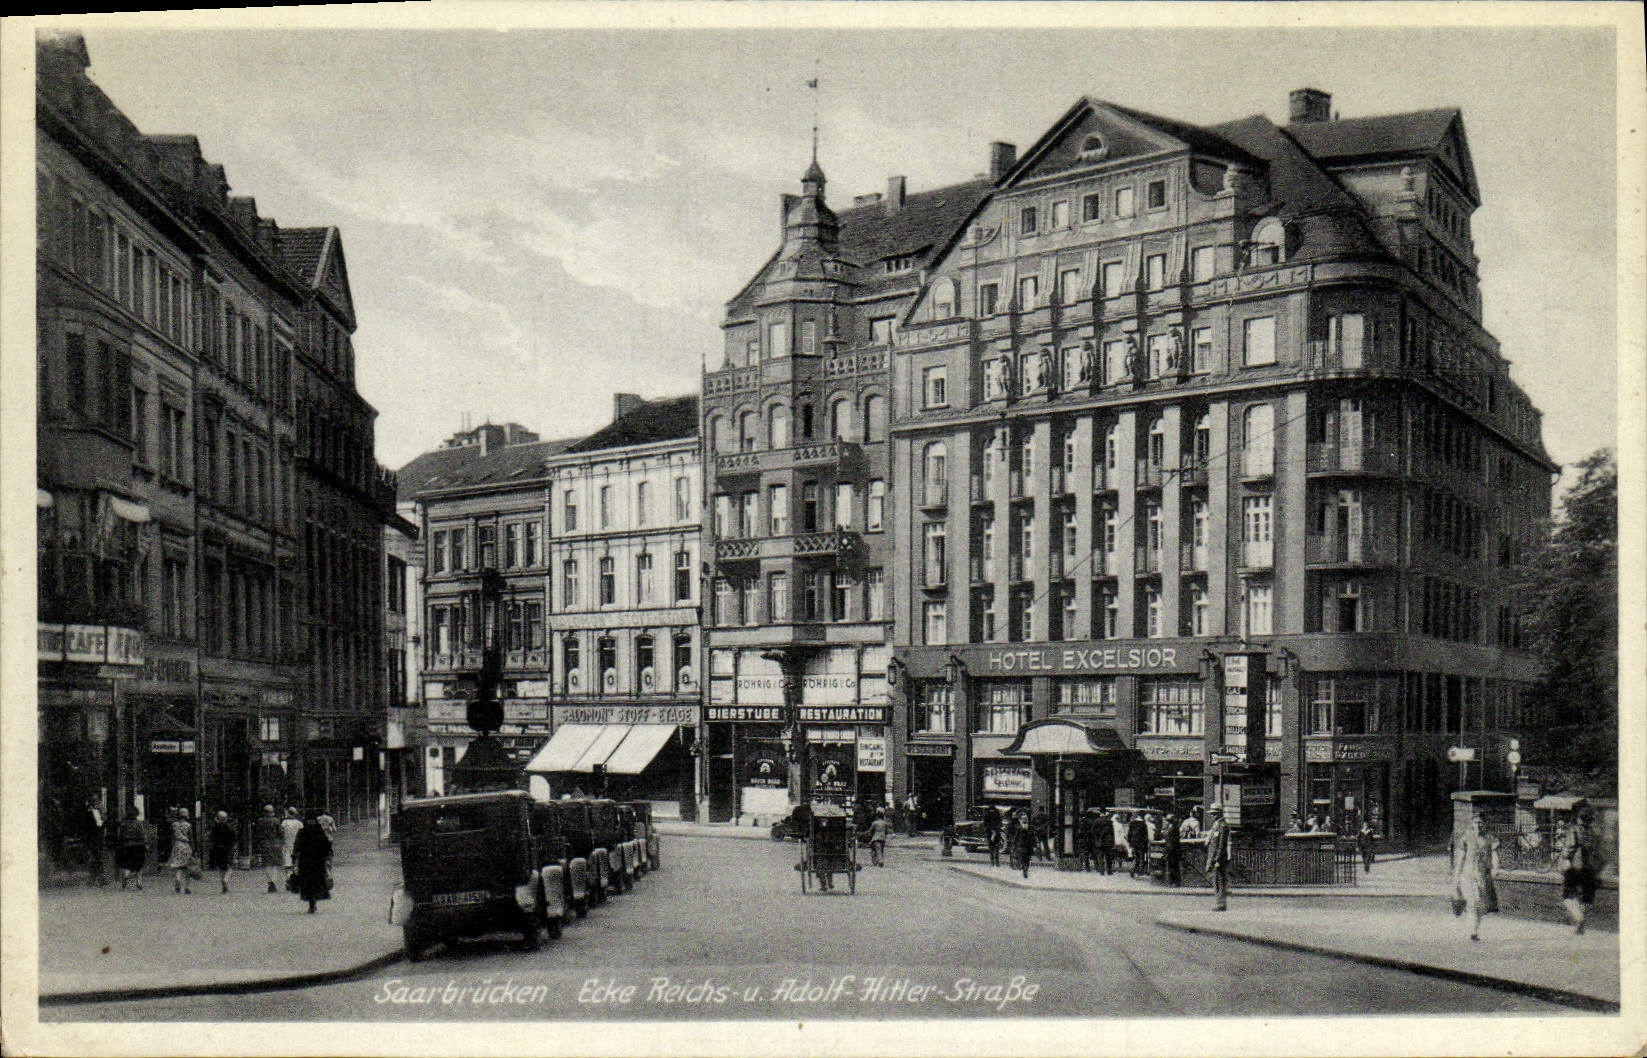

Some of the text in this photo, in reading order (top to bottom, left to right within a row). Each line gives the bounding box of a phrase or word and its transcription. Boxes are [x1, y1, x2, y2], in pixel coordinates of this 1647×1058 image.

[988, 648, 1177, 670] HOTEL EXCELSIOR
[708, 708, 779, 720] BIERSTUBE
[800, 709, 883, 720] RESTAURATION
